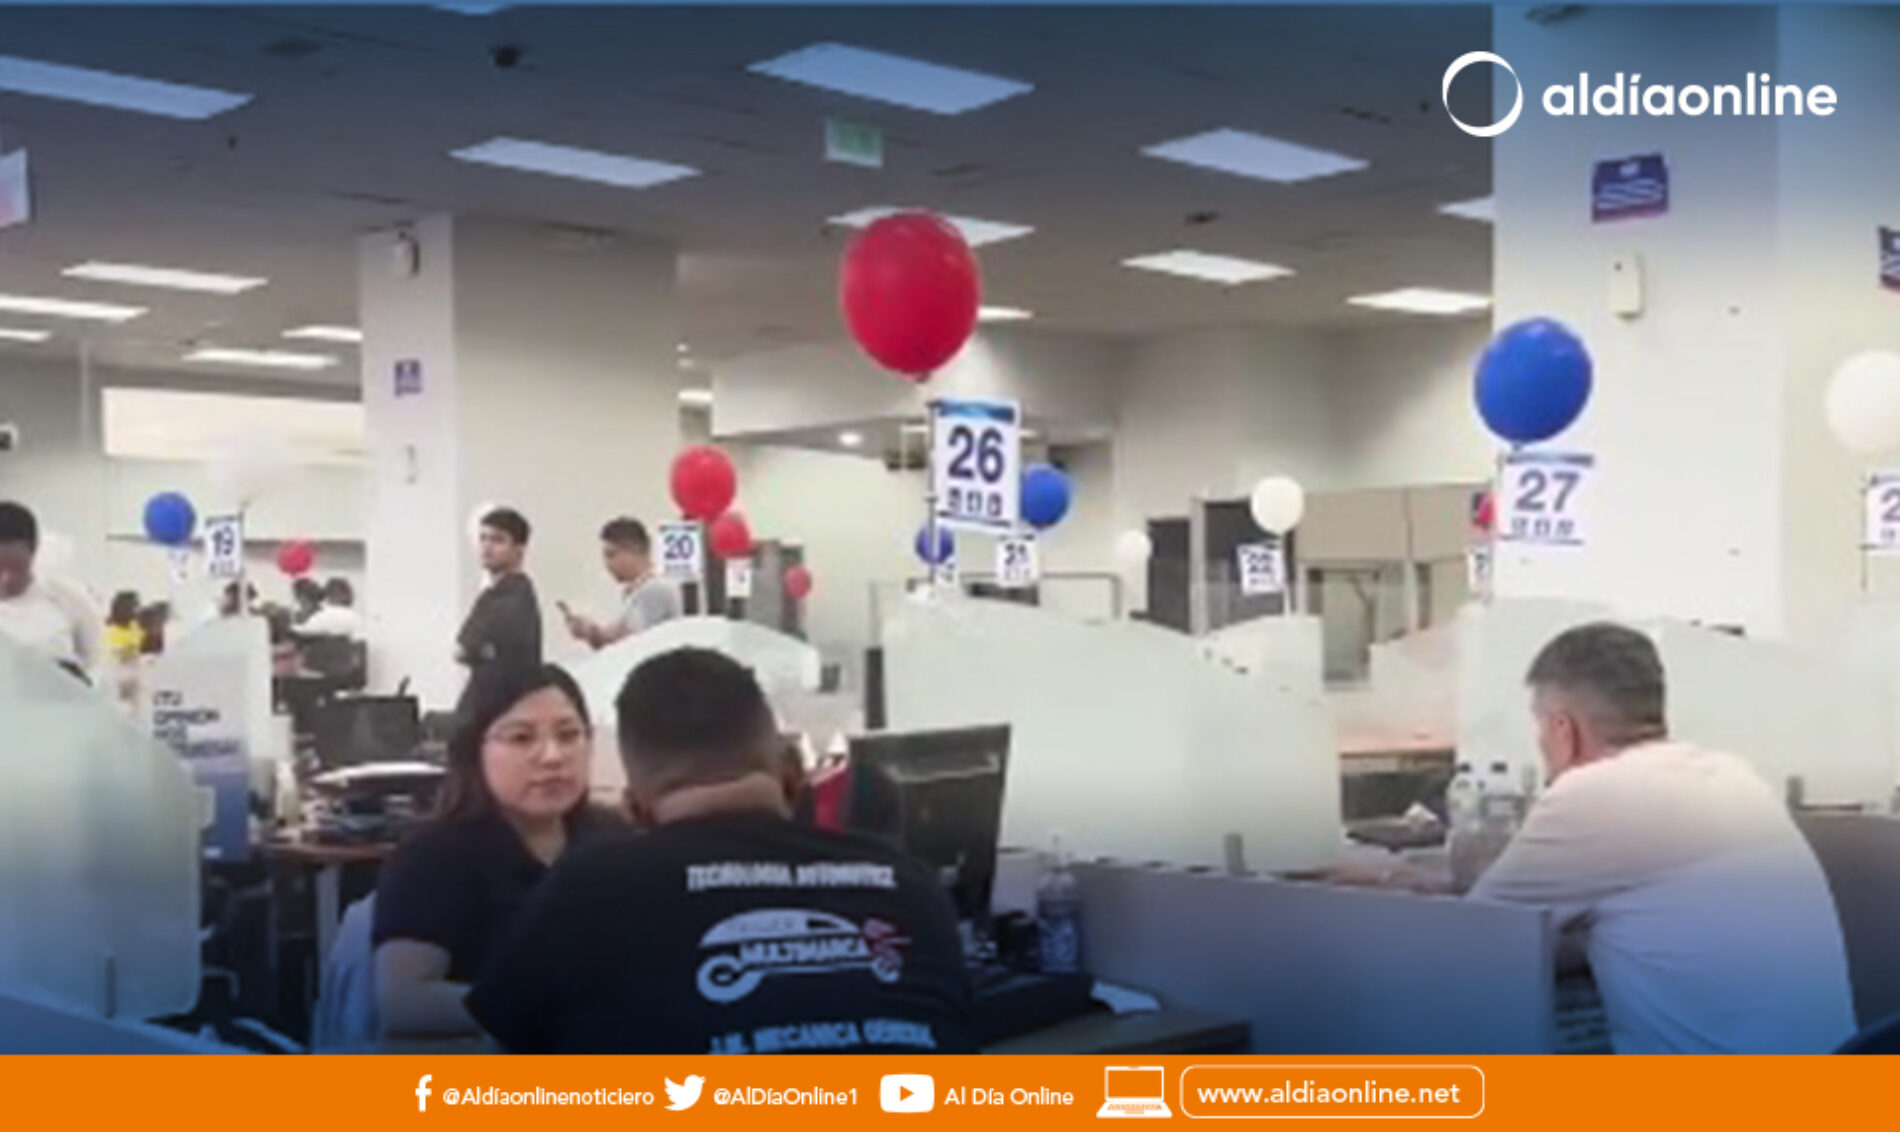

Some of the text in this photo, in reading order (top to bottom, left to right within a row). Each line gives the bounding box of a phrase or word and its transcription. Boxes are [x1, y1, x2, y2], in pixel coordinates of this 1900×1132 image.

[947, 424, 1004, 484] 26
[1515, 468, 1580, 513] 27
[212, 526, 234, 557] 19
[664, 534, 694, 560] 20
